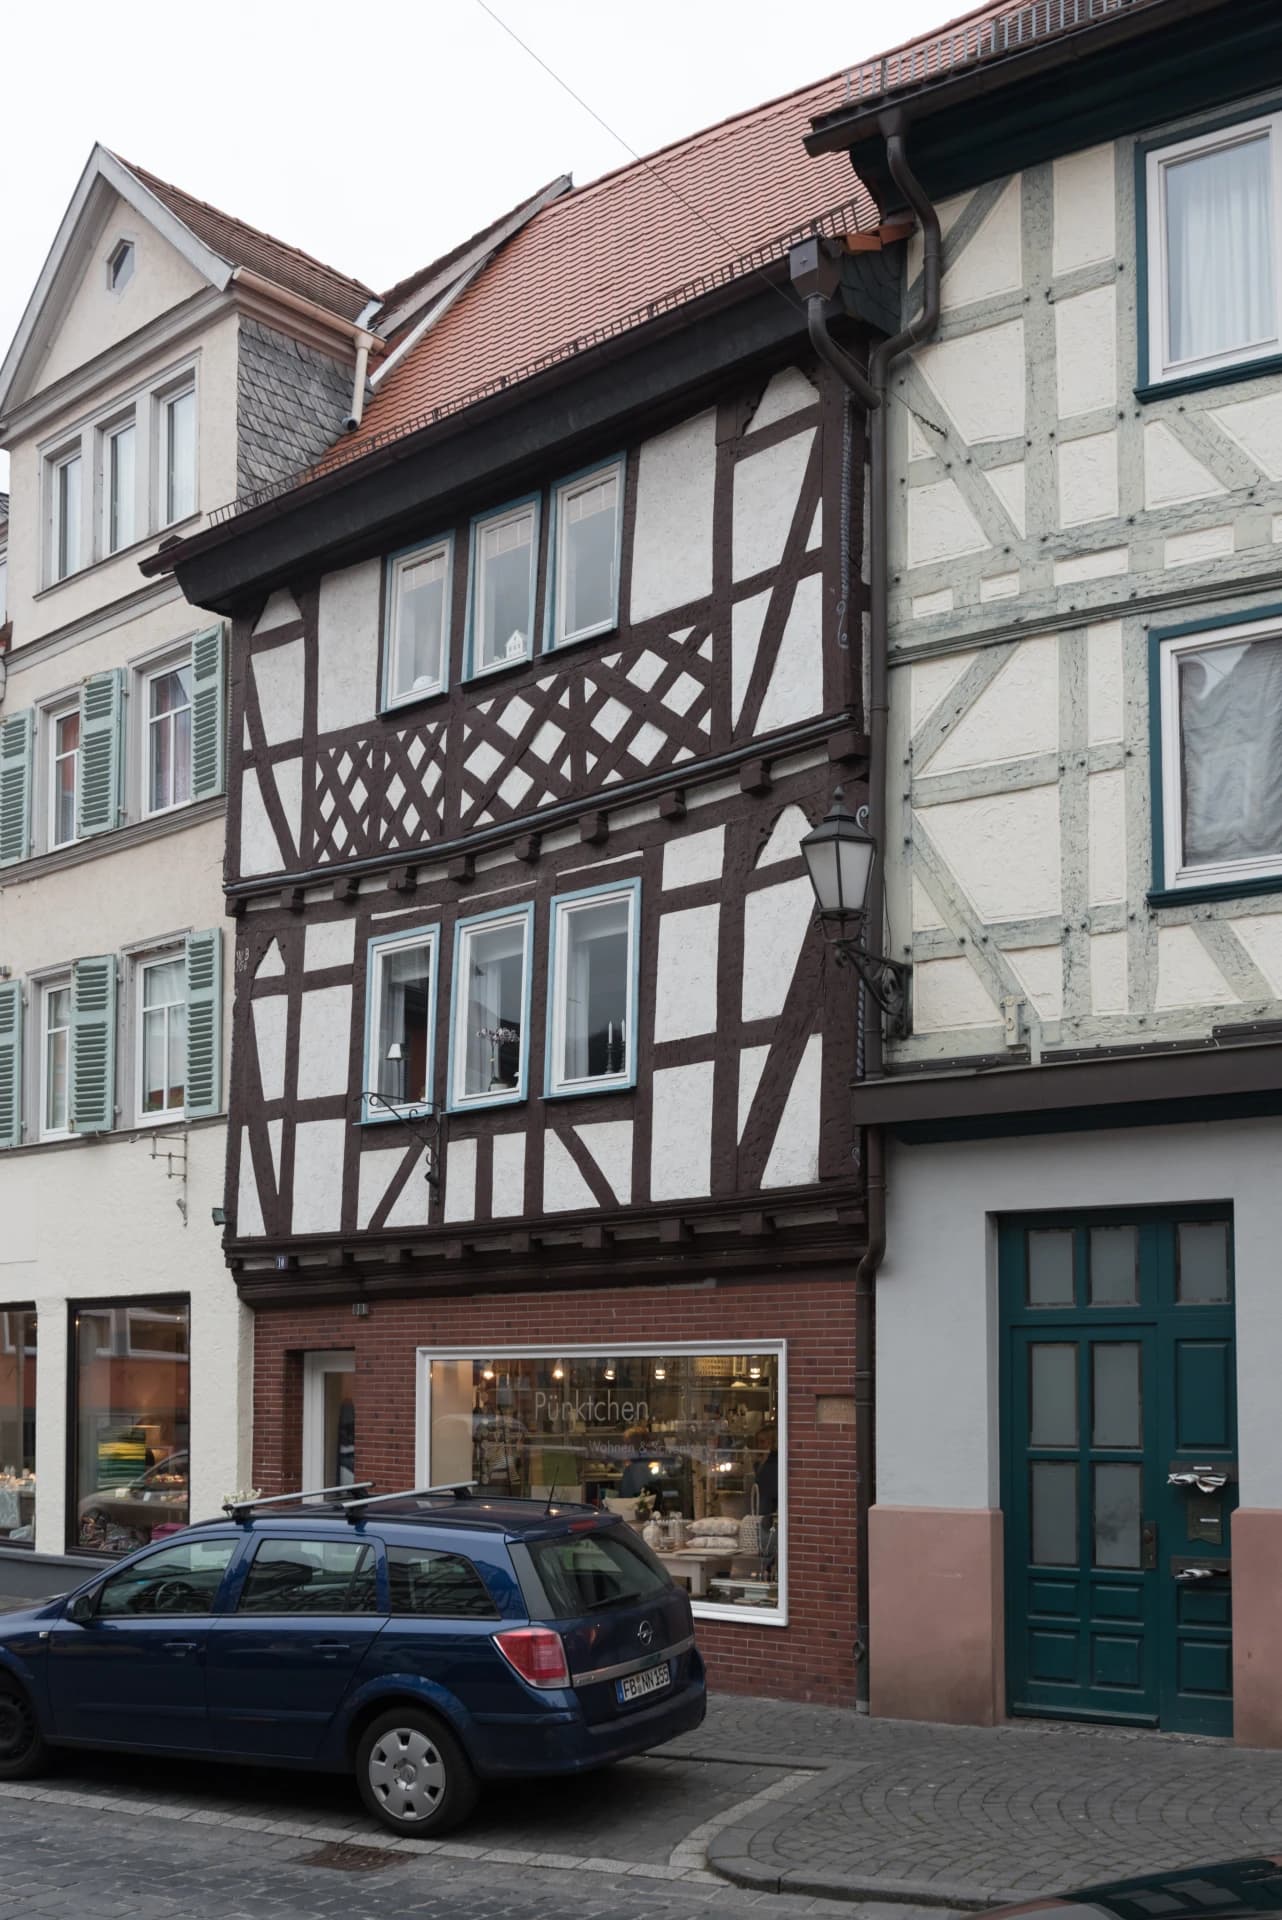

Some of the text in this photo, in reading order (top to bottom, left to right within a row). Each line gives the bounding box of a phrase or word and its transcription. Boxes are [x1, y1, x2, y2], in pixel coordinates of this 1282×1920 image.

[589, 1439, 635, 1454] Wohnen
[639, 1440, 648, 1453] &
[623, 1678, 637, 1698] FB
[641, 1671, 655, 1691] NN
[654, 1665, 669, 1686] 155
